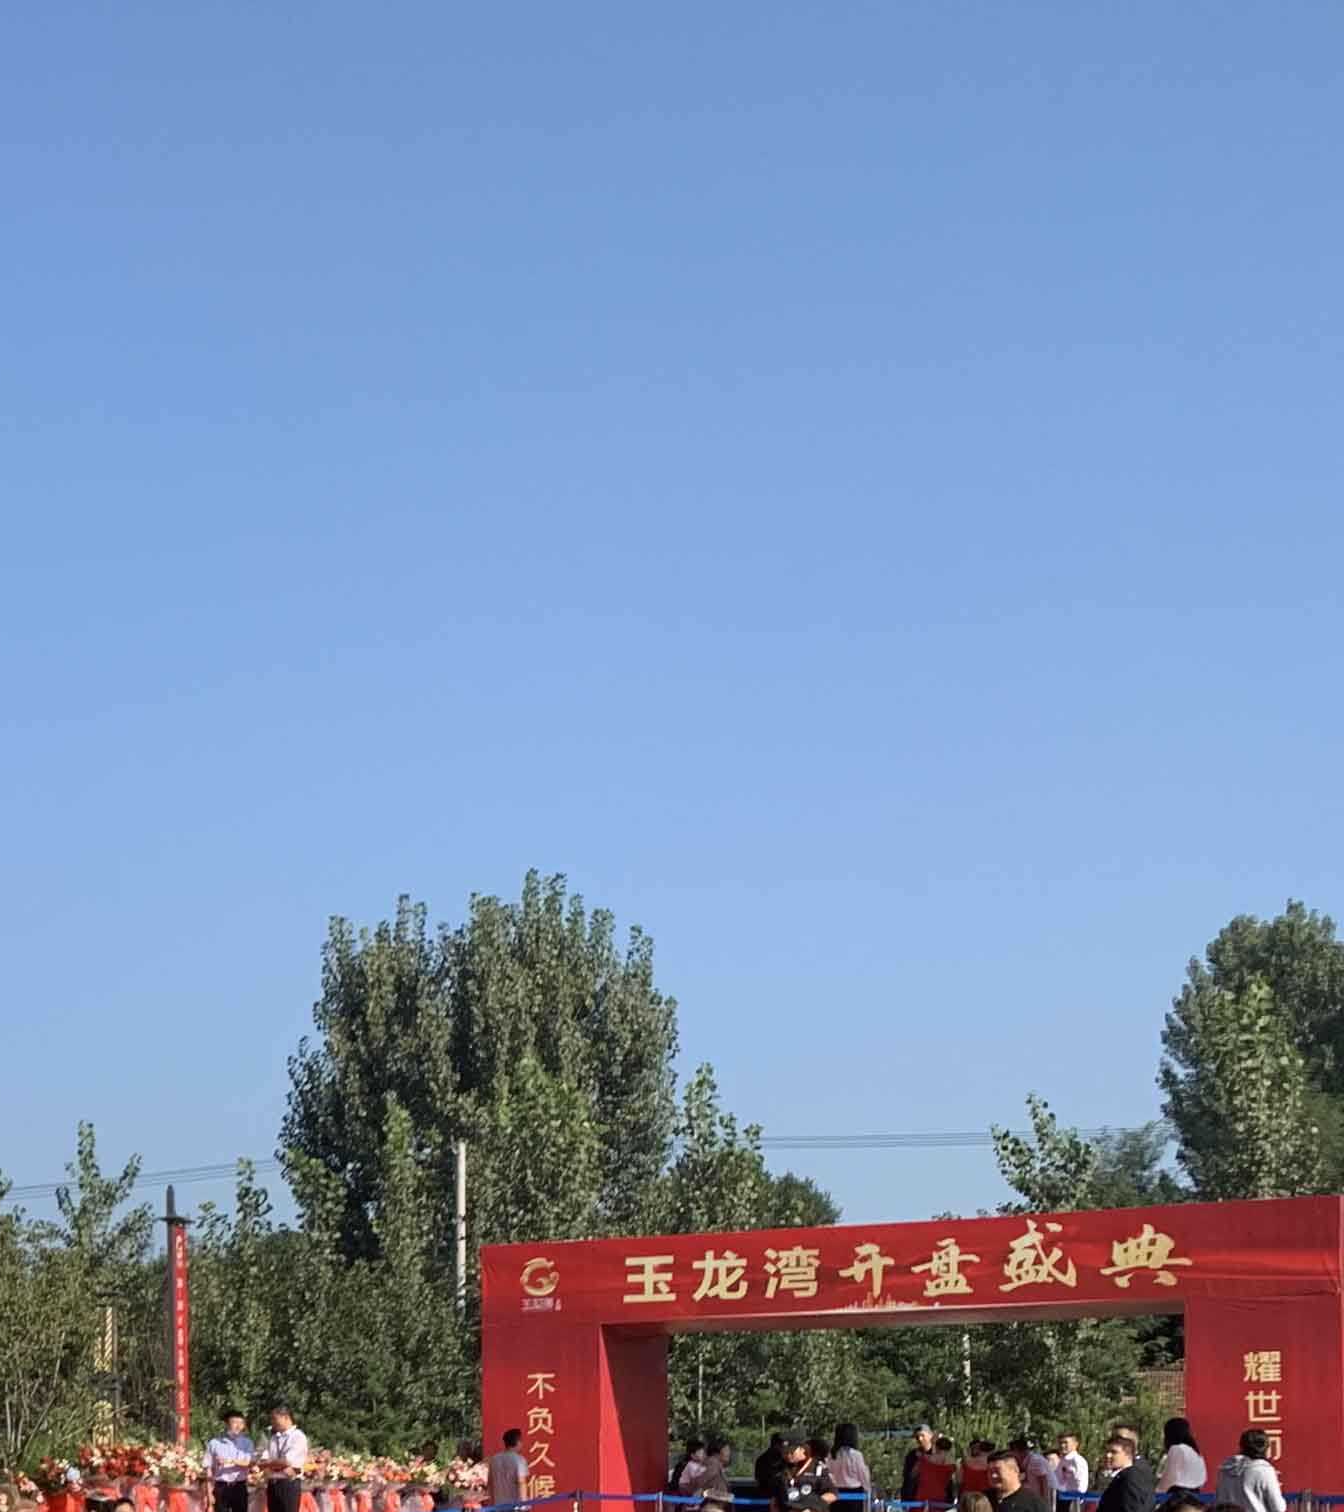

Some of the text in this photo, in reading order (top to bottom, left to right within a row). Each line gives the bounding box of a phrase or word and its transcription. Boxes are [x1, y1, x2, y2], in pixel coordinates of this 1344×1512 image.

[623, 1219, 1193, 1305] 玉龙湾开盘盛典
[526, 1372, 556, 1501] 不负久候
